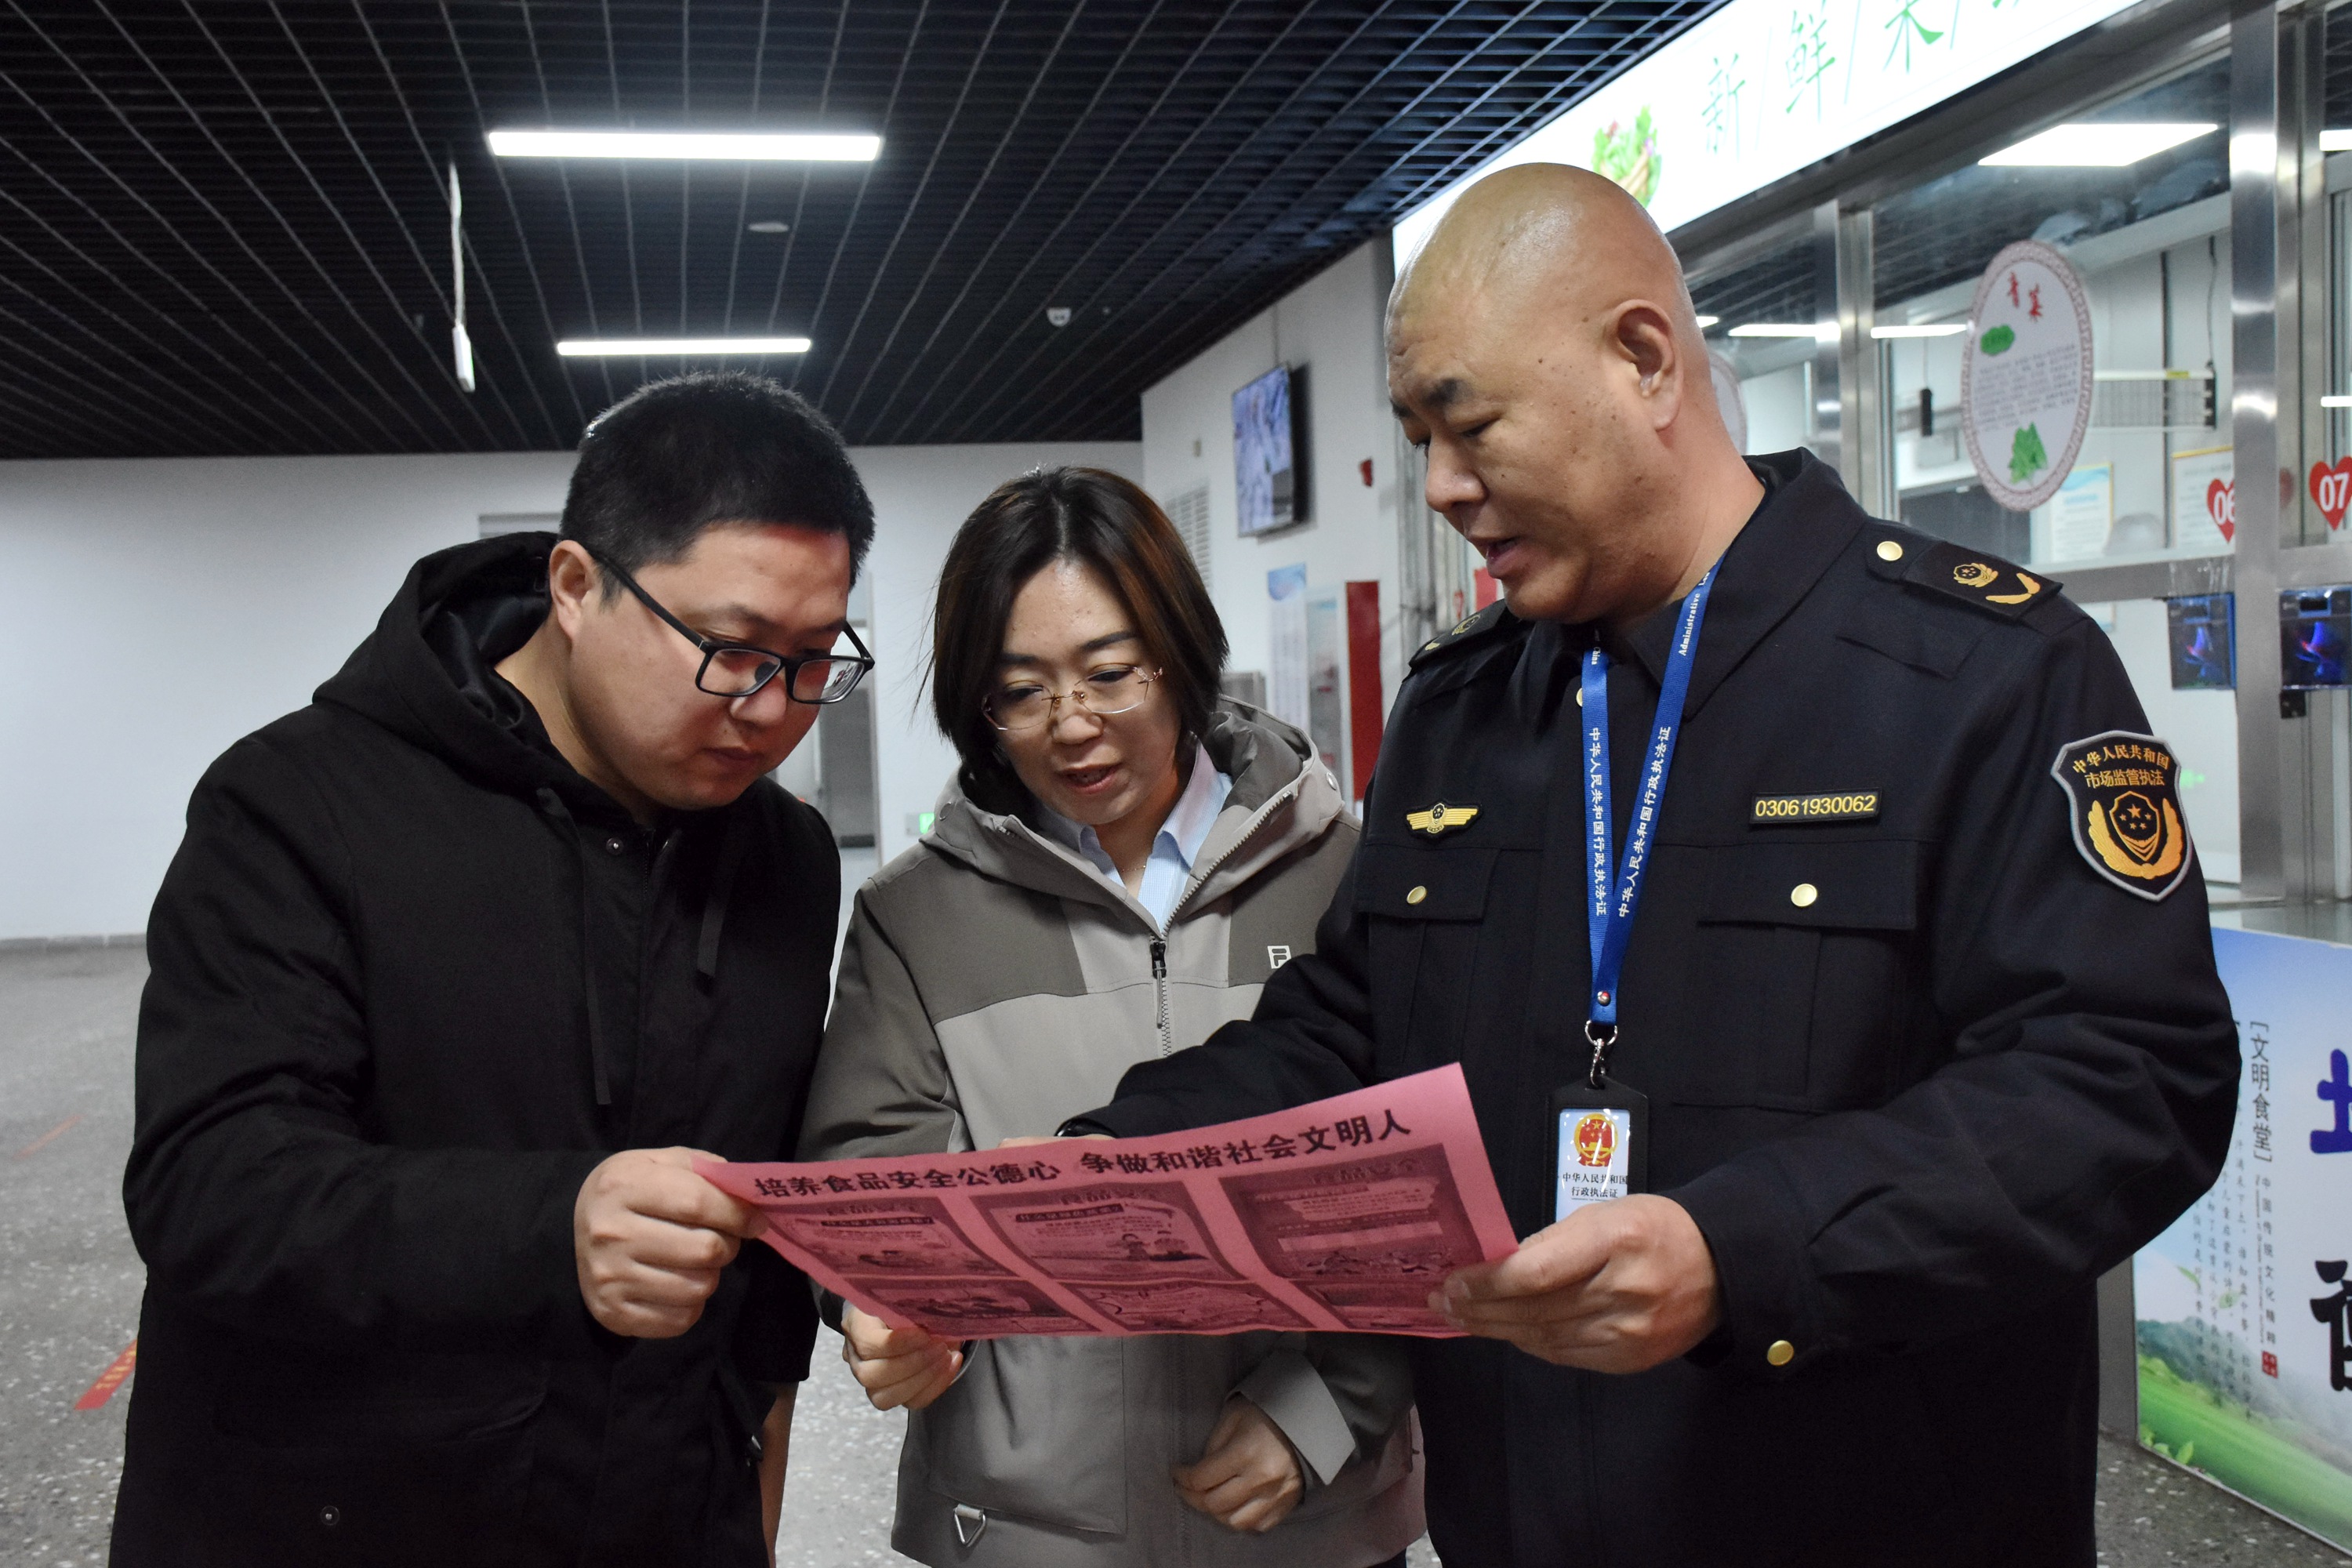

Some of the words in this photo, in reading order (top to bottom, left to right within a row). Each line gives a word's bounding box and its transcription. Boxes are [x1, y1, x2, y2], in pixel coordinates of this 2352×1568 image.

[2318, 471, 2349, 511] 07
[1678, 593, 1700, 656] Administrative
[2072, 744, 2170, 774] 中华人民共和国
[2085, 768, 2165, 789] 市场监管执法
[1588, 728, 1607, 916] 中华人民共和国行政执法证
[1618, 726, 1671, 917] 中华人民共和国行政执法证
[1755, 794, 1876, 818] 03061930062
[754, 1160, 1062, 1199] 培养食品安全公德心
[1080, 1107, 1412, 1175] 争做和谐社会文明人
[1571, 1186, 1618, 1198] 行政执法证
